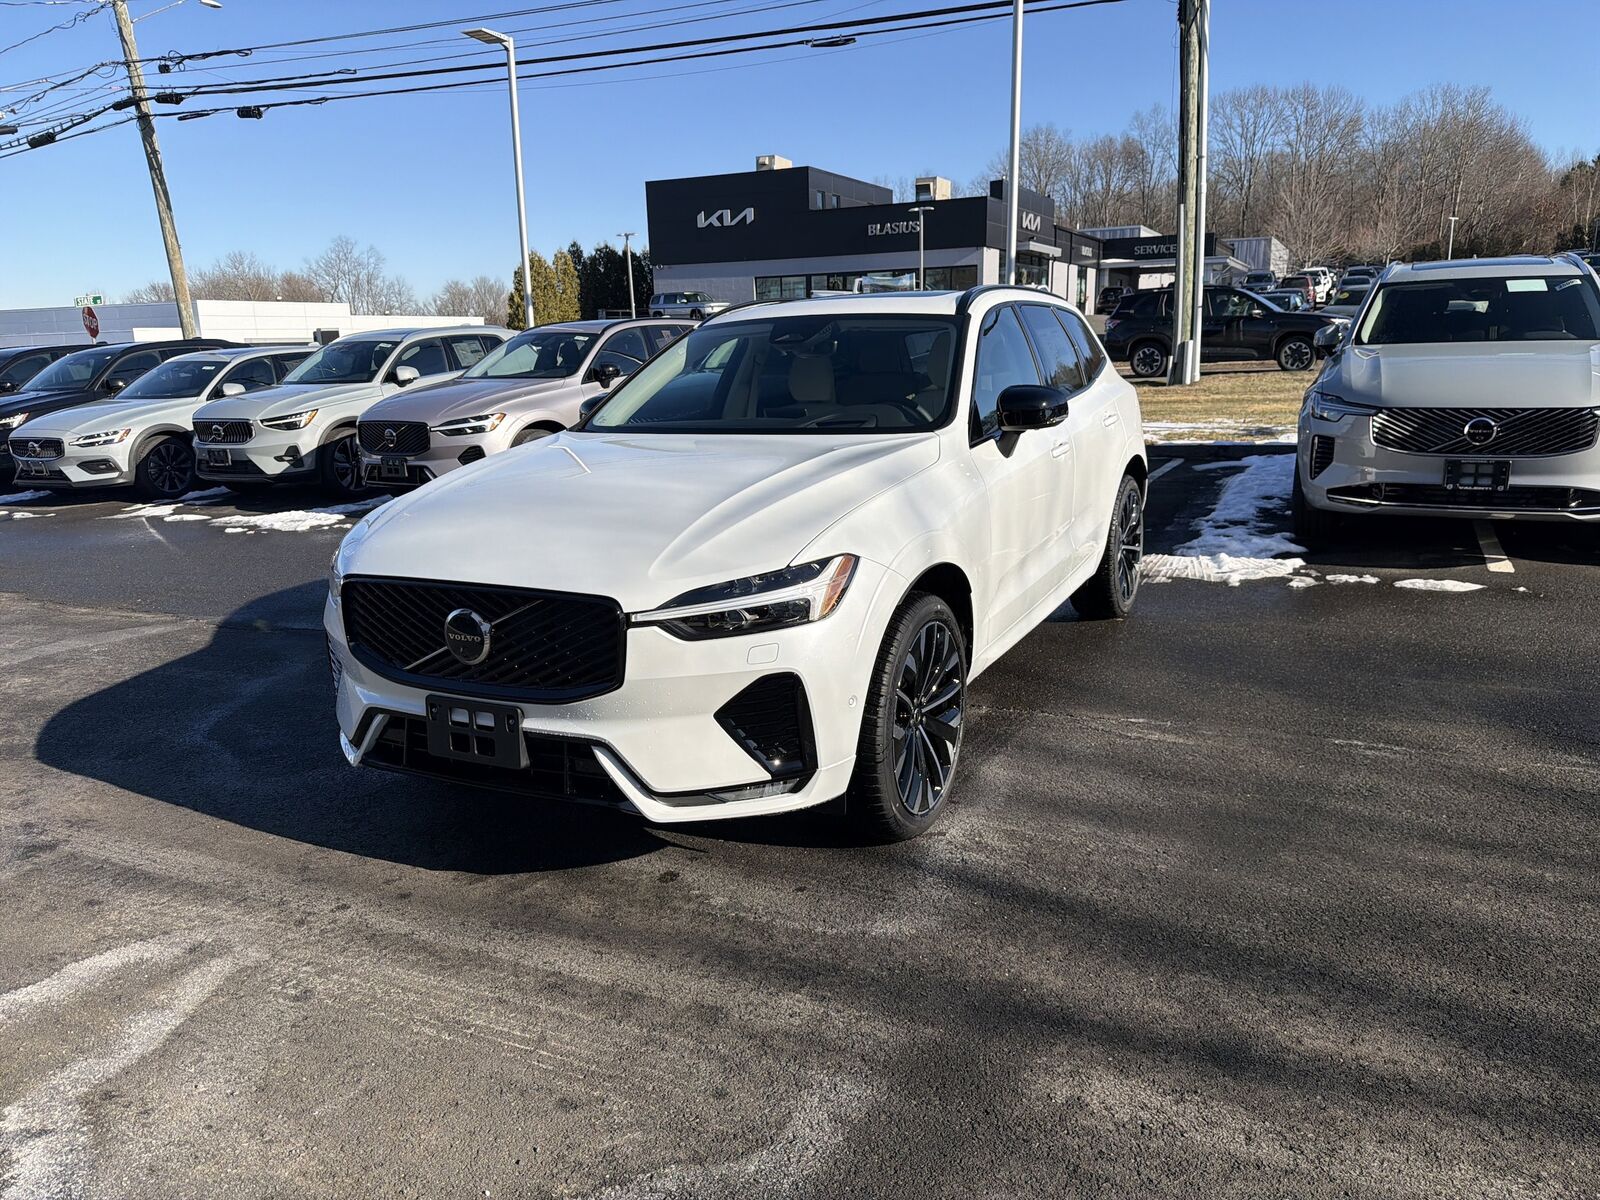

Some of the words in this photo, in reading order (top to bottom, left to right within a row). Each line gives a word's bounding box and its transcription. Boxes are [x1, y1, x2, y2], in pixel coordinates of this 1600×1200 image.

[697, 207, 754, 228] KIA
[868, 220, 920, 236] BLASIUS
[1134, 243, 1177, 255] SERVICE
[448, 633, 481, 642] VOLVO
